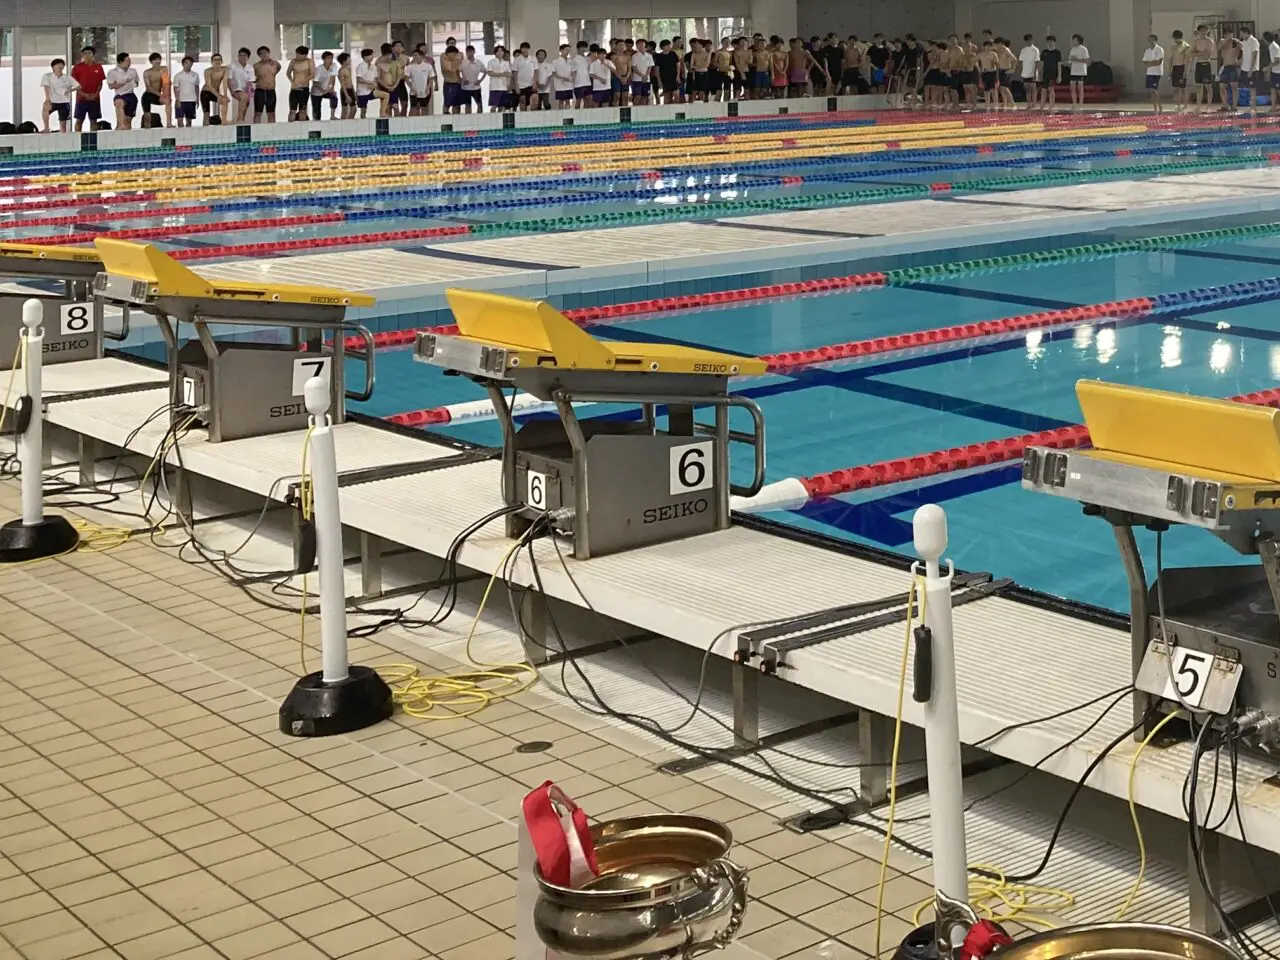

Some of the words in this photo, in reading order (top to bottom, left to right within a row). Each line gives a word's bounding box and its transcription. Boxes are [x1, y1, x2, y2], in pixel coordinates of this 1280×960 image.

[310, 296, 340, 304] SEIKO
[67, 306, 88, 331] 8
[42, 339, 89, 353] SEIKO
[694, 363, 727, 373] SEIKO
[186, 380, 192, 402] 7
[678, 448, 706, 488] 6
[531, 475, 542, 505] 6
[643, 498, 708, 525] SEIKO
[1175, 653, 1206, 698] 5
